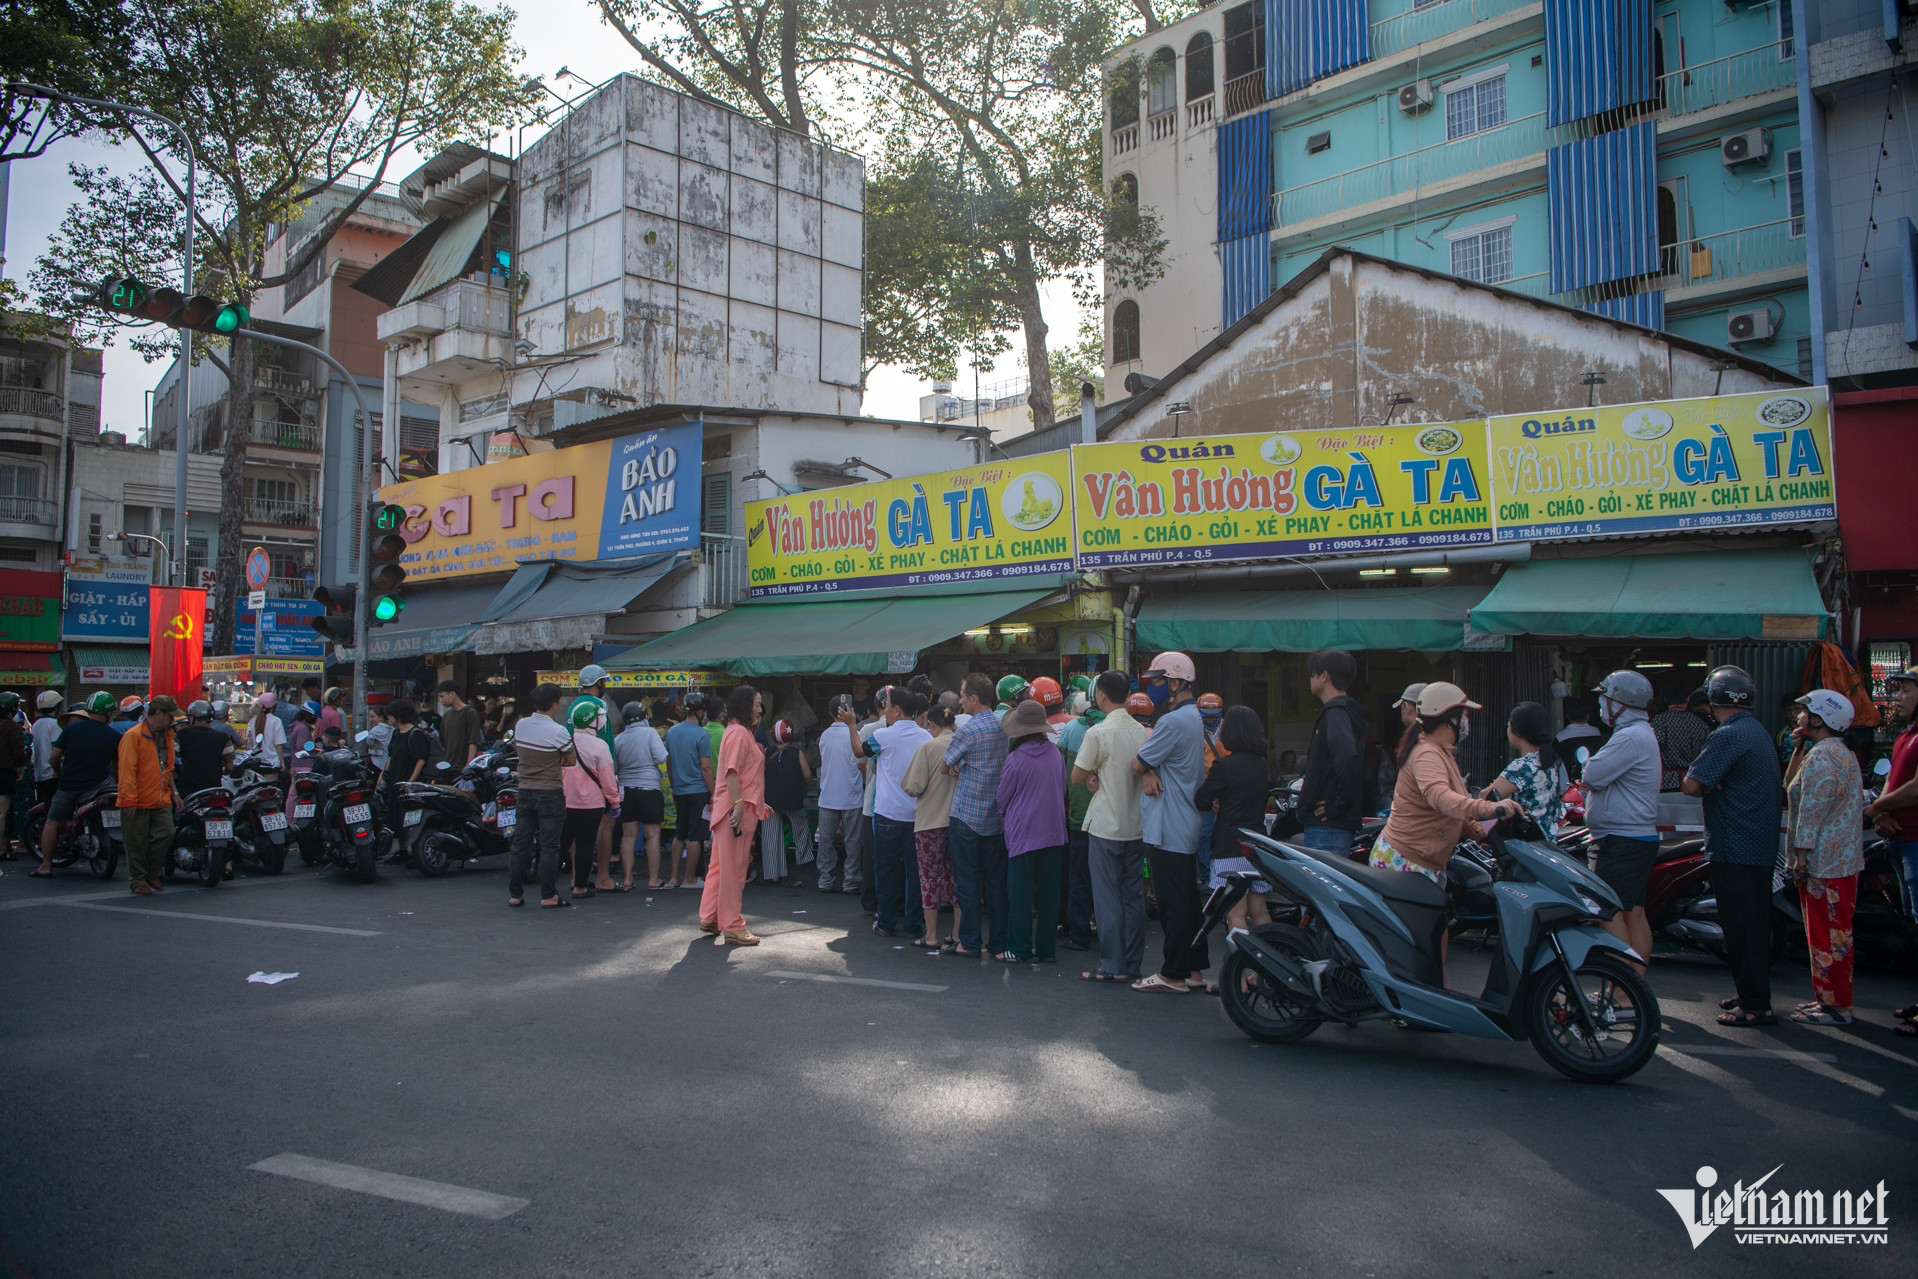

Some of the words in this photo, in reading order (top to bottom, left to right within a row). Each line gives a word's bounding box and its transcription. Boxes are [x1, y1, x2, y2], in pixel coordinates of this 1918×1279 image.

[112, 285, 135, 308] 21
[1521, 416, 1596, 439] Quán
[623, 438, 645, 455] Quán
[1140, 442, 1236, 464] Quán
[1316, 436, 1349, 452] Đặc
[1352, 434, 1385, 450] Biệt
[1672, 423, 1742, 486] GÀ
[1752, 428, 1824, 479] TA
[622, 446, 678, 491] BẢO
[1497, 443, 1564, 495] Vân
[1566, 438, 1670, 491] Hương
[950, 473, 975, 488] Đặc
[978, 469, 1004, 484] Biệt
[1303, 451, 1385, 511] GÀ
[1400, 456, 1482, 505] TA
[491, 475, 576, 529] Ta
[620, 479, 676, 525] ANH
[1083, 469, 1165, 520] Vân
[1171, 466, 1298, 516] Hương
[1500, 501, 1529, 521] CƠM
[1547, 496, 1585, 517] CHÁO
[1598, 490, 1622, 514] GỎI
[1636, 489, 1654, 511] XÉ
[1659, 490, 1697, 510] PHAY
[1711, 484, 1750, 509] CHẶT
[1755, 480, 1774, 503] LÁ
[1779, 480, 1830, 501] CHANH
[377, 510, 396, 529] 21
[887, 483, 934, 548] GÀ
[943, 486, 995, 542] TA
[1498, 530, 1514, 539] 135
[1518, 525, 1542, 538] TRẦN
[1544, 524, 1562, 536] PHÚ
[1564, 525, 1579, 534] P.4
[1586, 524, 1601, 533] Q.5
[1699, 513, 1763, 526] 0909.347.366
[1771, 507, 1834, 520] 0909184.678
[551, 530, 577, 543] NAM
[765, 502, 808, 557] Vân
[808, 497, 878, 554] Hương
[1082, 526, 1121, 547] CƠM
[1144, 520, 1192, 543] CHÁO
[1209, 516, 1239, 540] GỎI
[1256, 514, 1278, 537] XÉ
[1285, 516, 1331, 535] PHAY
[1348, 509, 1395, 534] CHẶT
[1401, 506, 1423, 527] LÁ
[1429, 506, 1488, 526] CHANH
[751, 565, 776, 582] CƠM
[790, 560, 823, 578] CHÁO
[834, 555, 856, 574] GỎI
[868, 553, 885, 571] XÉ
[890, 551, 926, 569] PHAY
[940, 544, 980, 567] CHẶT
[985, 540, 1005, 561] LÁ
[1010, 536, 1067, 557] CHANH
[1080, 555, 1101, 565] 135
[1107, 551, 1137, 564] TRẦN
[1140, 550, 1163, 561] PHÚ
[1166, 550, 1184, 560] P.4
[1194, 549, 1212, 559] Q.5
[1333, 537, 1409, 550] 0909.347.366
[1419, 533, 1491, 546] 0909184.678
[105, 572, 148, 582] LAUNDRY
[202, 570, 216, 582] SA
[751, 588, 764, 597] 135
[767, 582, 787, 595] TRẦN
[789, 583, 804, 593] PHÚ
[806, 583, 818, 592] P.4
[824, 582, 838, 591] Q.5
[928, 569, 993, 583] 0909.347.366
[1002, 561, 1071, 576] 0909184.678
[0, 596, 43, 617] EBAB
[69, 590, 106, 607] GIẶT
[116, 592, 147, 607] HẤP
[78, 609, 109, 626] SẤY
[120, 611, 137, 627] ỦI
[287, 662, 298, 670] SEN
[3, 673, 48, 685] ebab
[540, 673, 570, 683] CƠM
[665, 673, 687, 682] GÀ
[1008, 683, 1022, 693] Grab
[1729, 691, 1748, 700] evo
[583, 712, 595, 722] Grab
[346, 805, 366, 815] 59-F1
[209, 822, 228, 830] 59-U1
